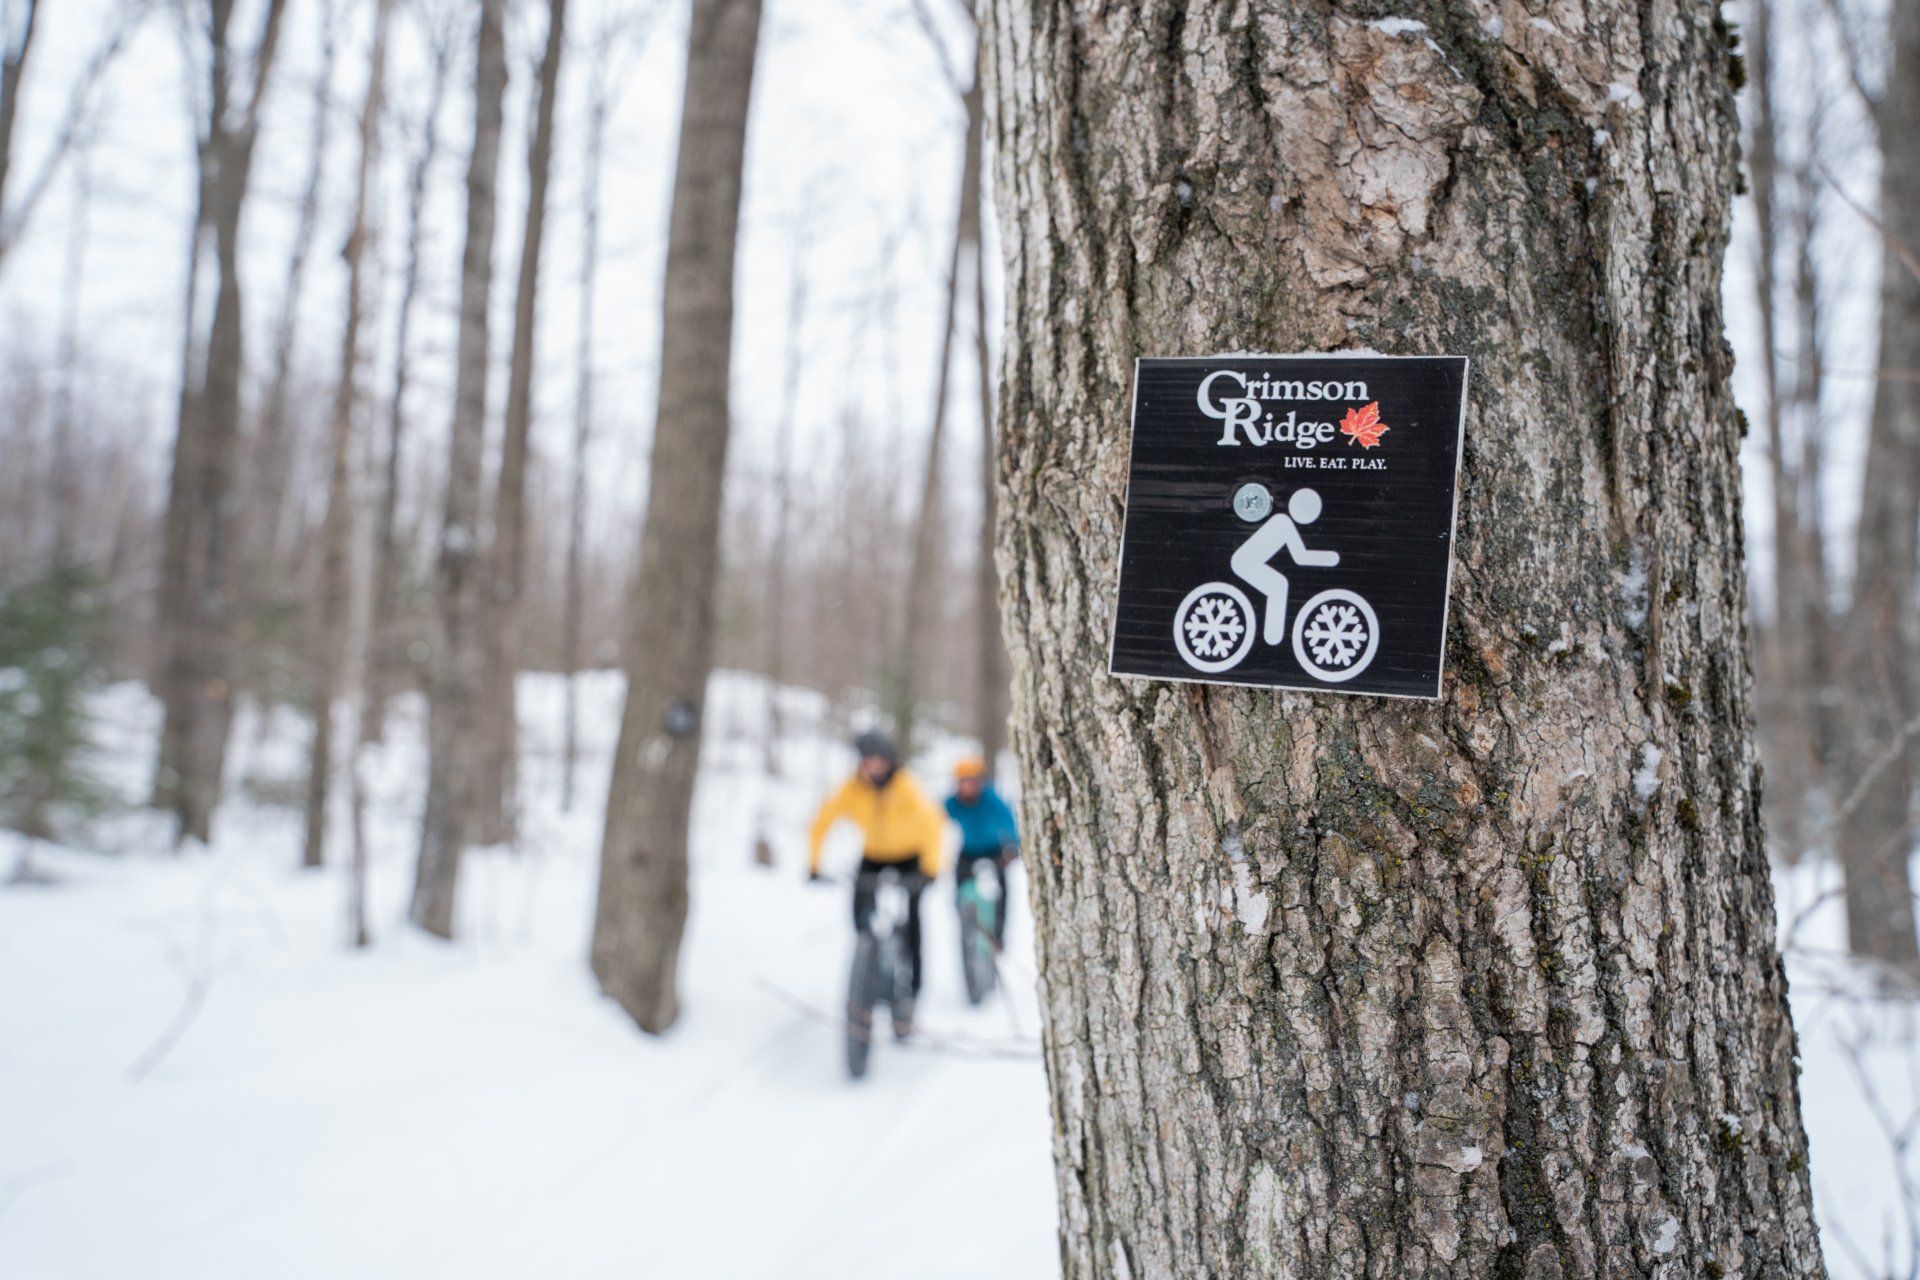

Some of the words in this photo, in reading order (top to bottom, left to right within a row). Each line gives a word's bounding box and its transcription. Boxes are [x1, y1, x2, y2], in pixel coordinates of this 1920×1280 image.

[1197, 370, 1370, 419] Crimson
[1217, 398, 1335, 449] Ridge
[1284, 456, 1316, 468] LIVE.
[1319, 457, 1347, 469] EAT.
[1352, 458, 1387, 470] PLAY.
